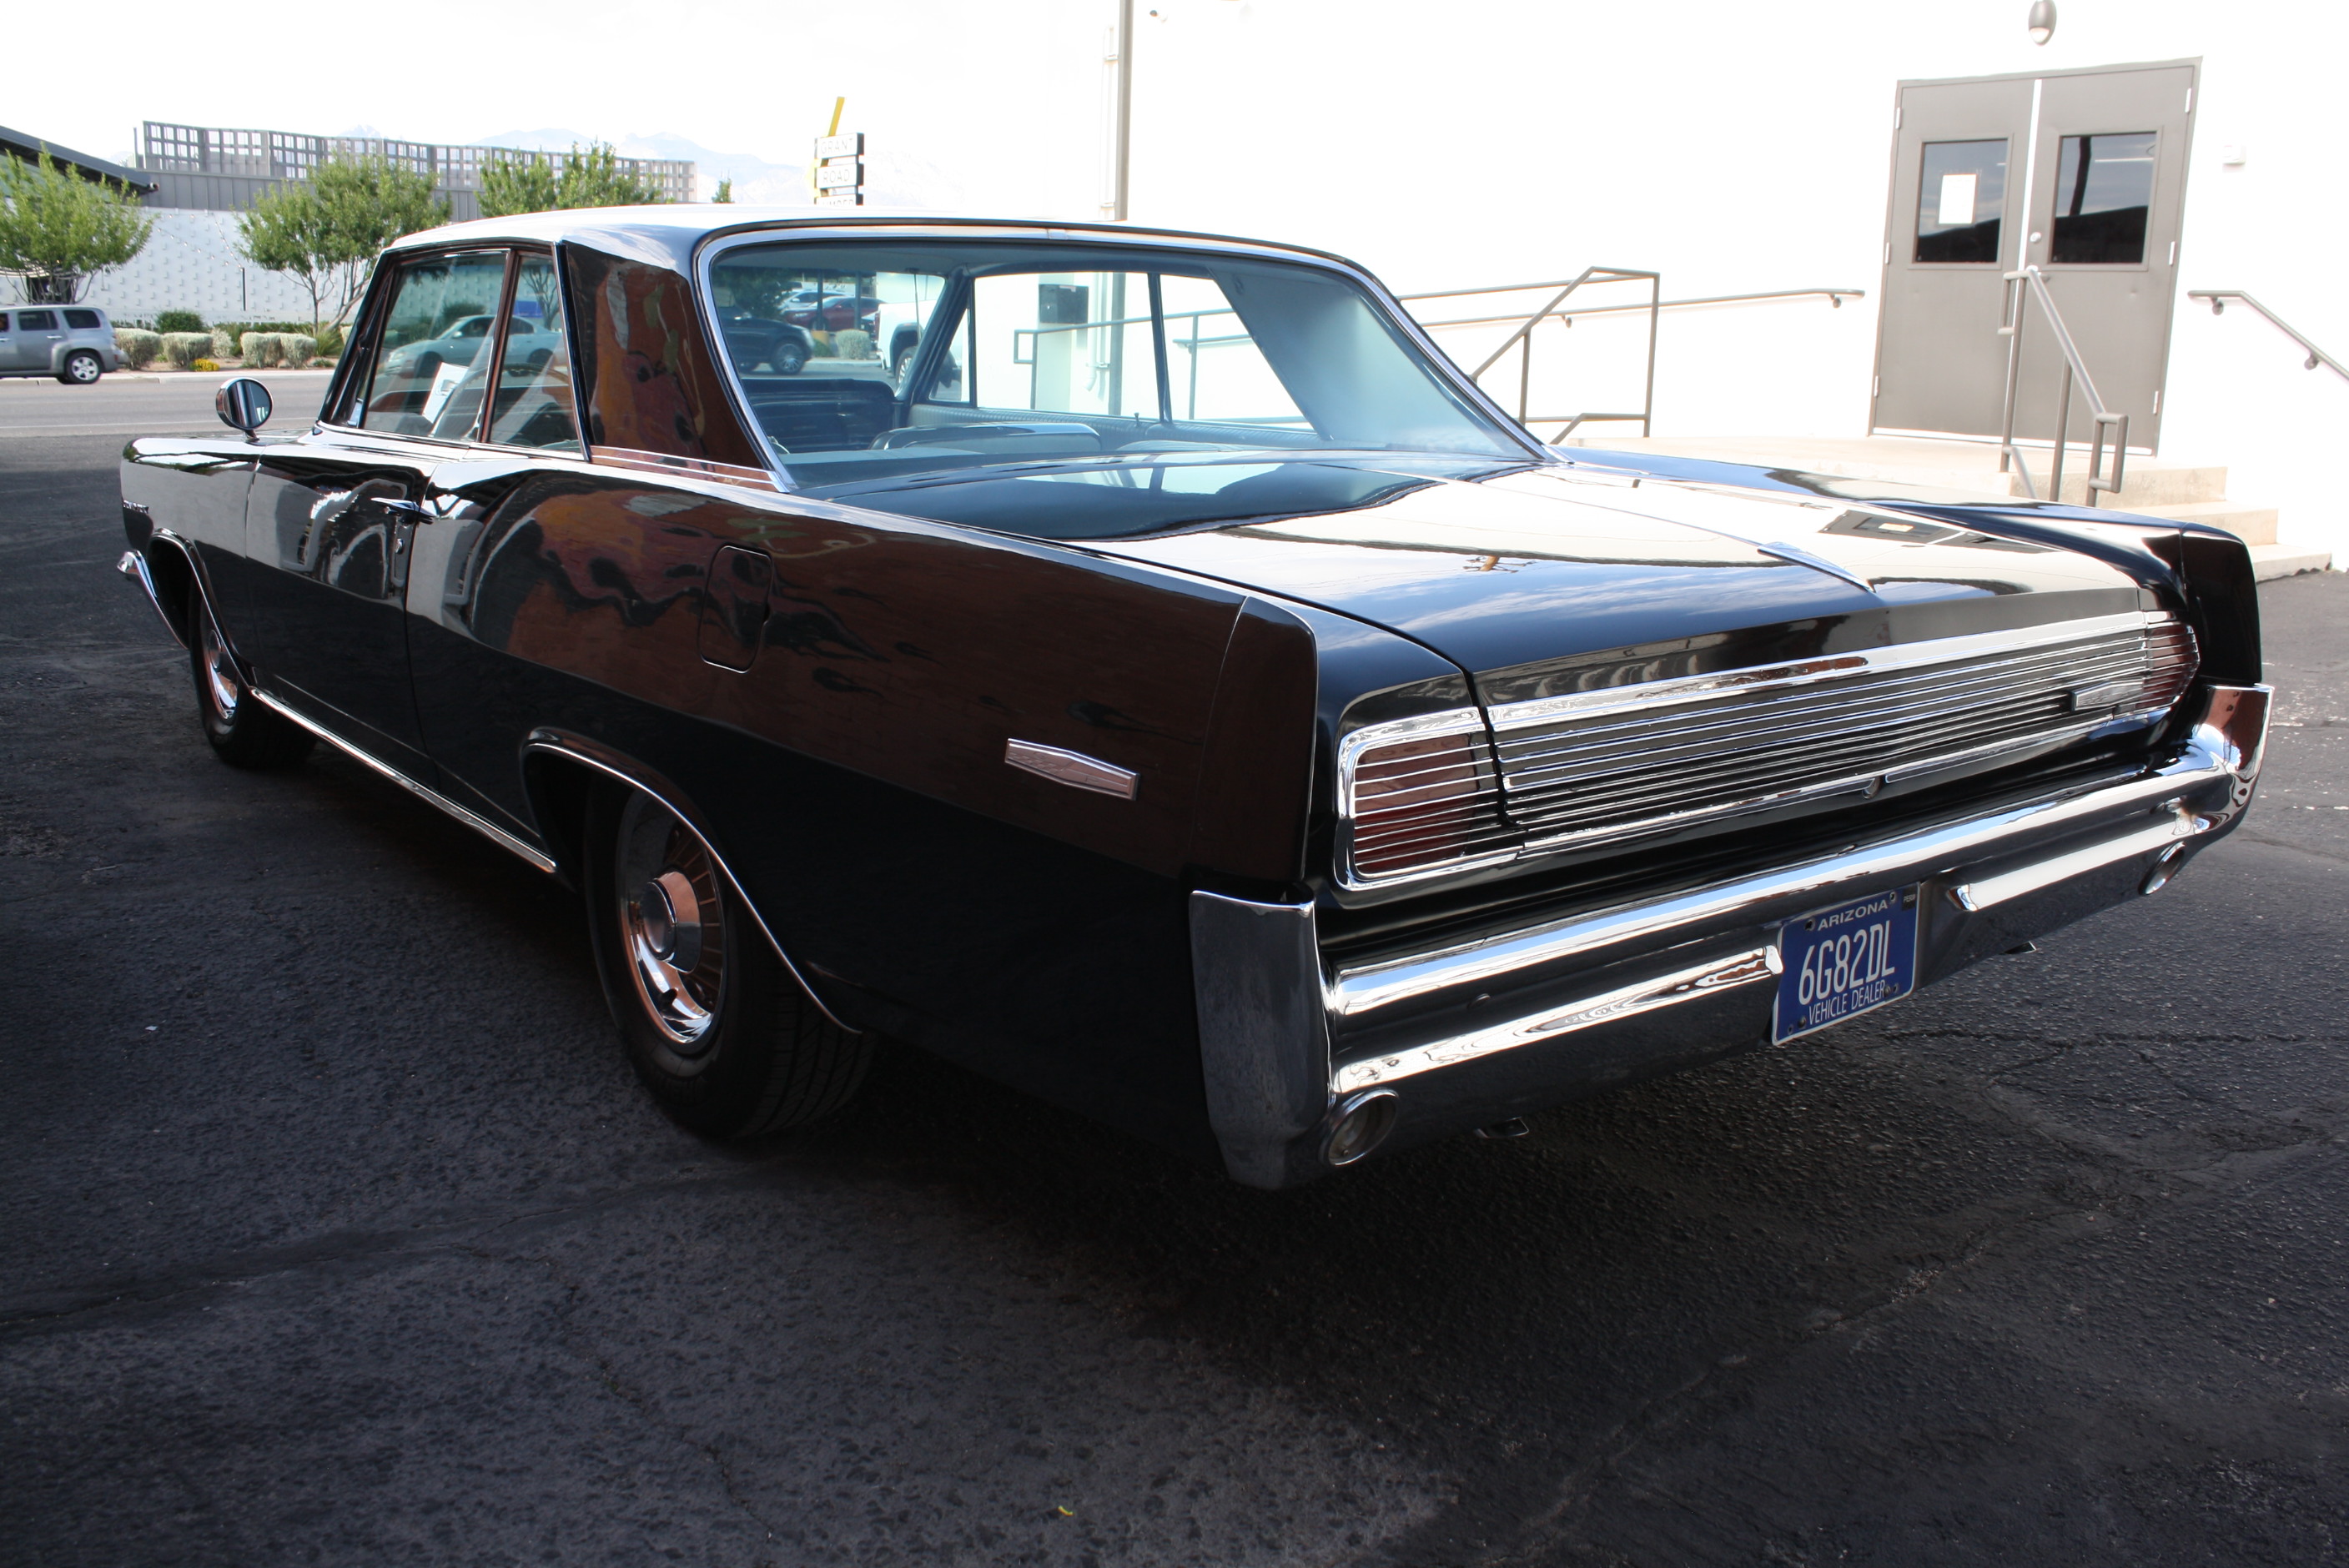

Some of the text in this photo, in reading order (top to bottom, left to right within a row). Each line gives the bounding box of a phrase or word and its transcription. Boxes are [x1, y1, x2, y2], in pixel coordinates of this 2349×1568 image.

[821, 138, 853, 154] GRANT
[823, 168, 850, 183] ROAD
[1818, 899, 1888, 931] ARIZONA
[1798, 920, 1895, 1005] 6G82DL
[1809, 979, 1885, 1025] VEHICLE DEALER
